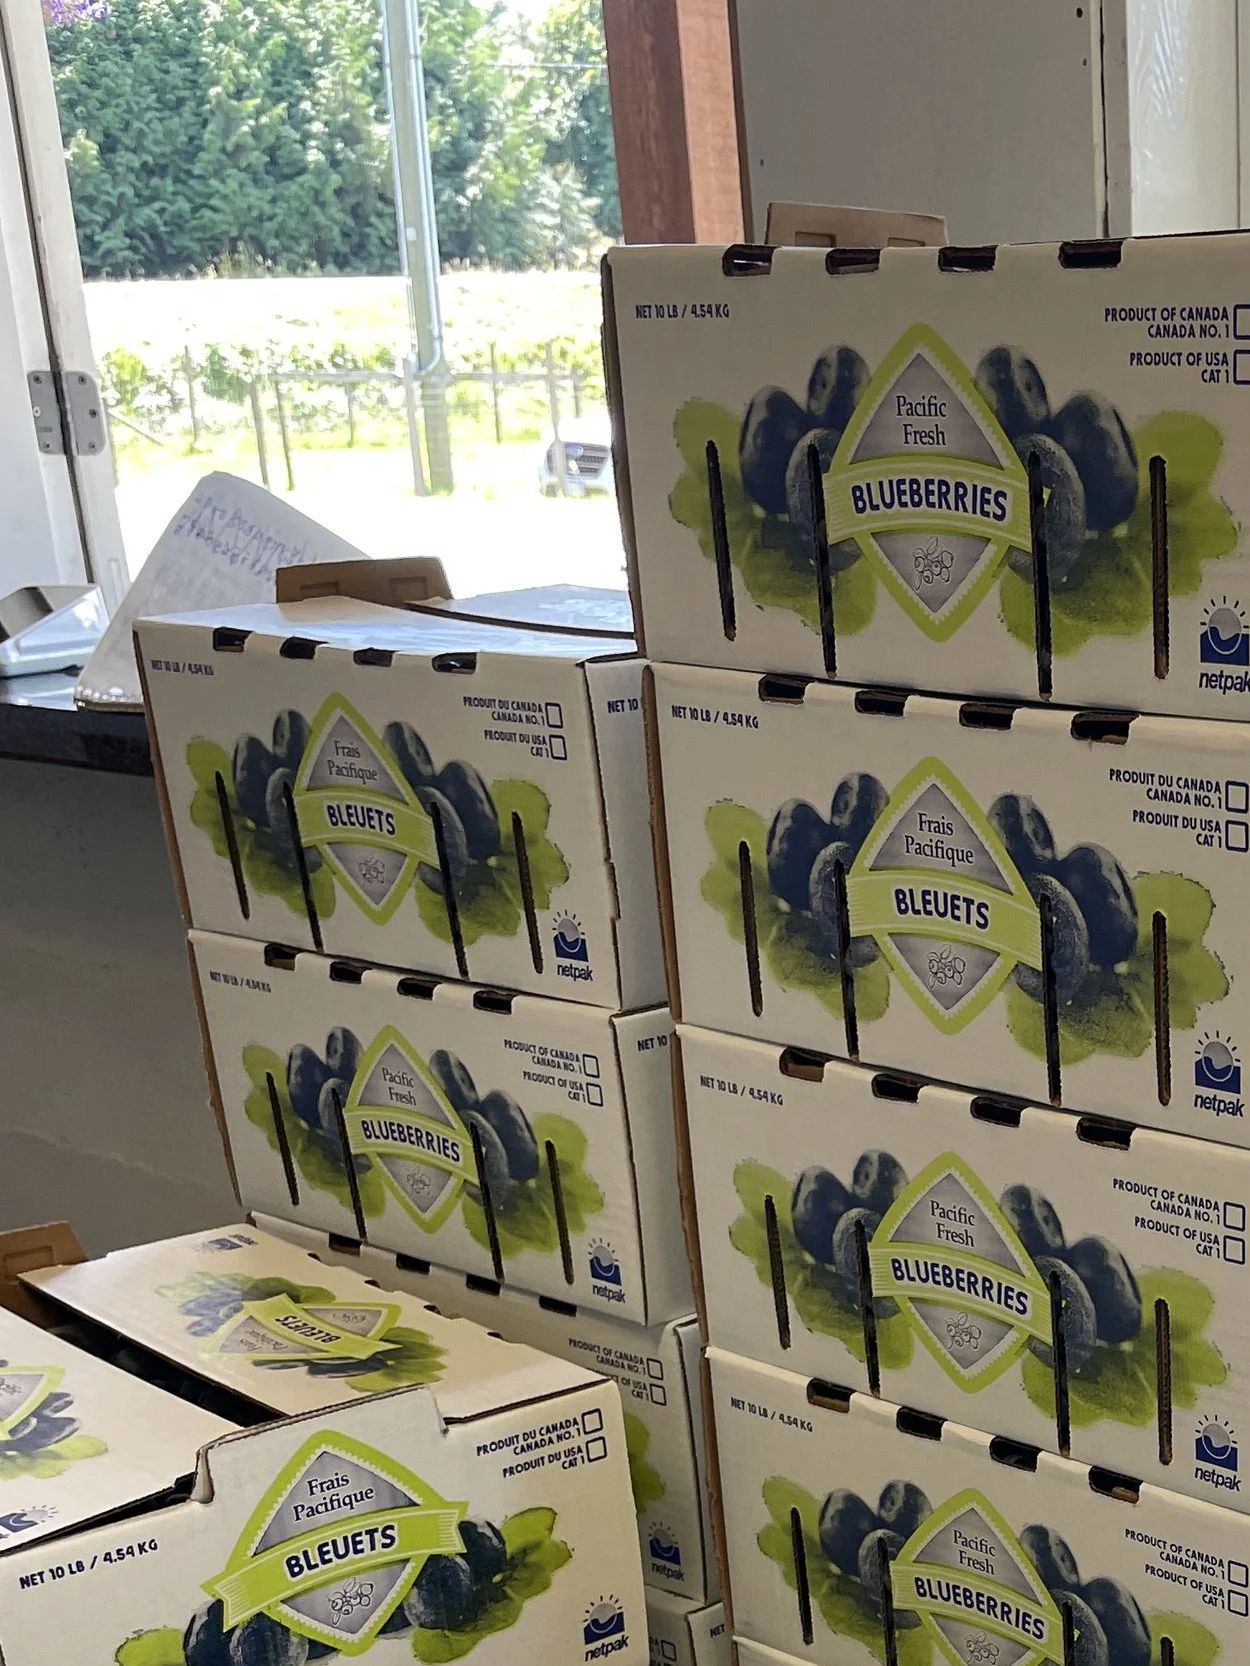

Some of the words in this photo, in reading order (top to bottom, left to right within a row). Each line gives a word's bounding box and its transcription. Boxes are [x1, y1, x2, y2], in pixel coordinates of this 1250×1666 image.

[636, 305, 652, 318] NET
[655, 304, 664, 318] 10
[667, 304, 678, 318] LB
[691, 304, 713, 318] 4.54
[715, 304, 729, 318] KG
[1105, 308, 1156, 322] PRODUCT
[1161, 307, 1176, 321] OF
[1180, 307, 1229, 321] CANADA
[1148, 324, 1195, 338] CANADA
[1200, 324, 1221, 338] NO.
[1130, 352, 1182, 366] PRODUCT
[1186, 352, 1202, 366] OF
[1206, 352, 1229, 366] USA
[1201, 369, 1221, 383] CAT
[896, 395, 946, 417] Pacific
[903, 424, 946, 445] Fresh
[852, 482, 1007, 521] BLUEBERRIES
[608, 700, 625, 713] NET
[628, 698, 638, 711] 10
[327, 804, 395, 835] BLEUETS
[918, 813, 953, 835] Frais
[905, 835, 973, 867] Pacifique
[895, 889, 988, 929] BLEUETS
[557, 963, 593, 981] netpak
[382, 1067, 414, 1088] Pacific
[388, 1087, 416, 1106] Fresh
[1194, 1094, 1245, 1117] netpak
[361, 1120, 460, 1162] BLUEBERRIES
[930, 1200, 974, 1226] Pacific
[936, 1222, 974, 1247] Fresh
[593, 1285, 625, 1303] netpak
[891, 1258, 1027, 1315] BLUEBERRIES
[477, 1435, 519, 1456] PRODUIT
[523, 1430, 536, 1442] DU
[539, 1417, 579, 1436] CANADA
[514, 1436, 554, 1455] CANADA
[556, 1431, 574, 1442] NO.
[503, 1456, 545, 1478] PRODUIT
[548, 1451, 561, 1463] DU
[564, 1445, 584, 1463] USA
[562, 1457, 577, 1469] CAT
[307, 1473, 349, 1500] Frais
[1195, 1467, 1241, 1491] netpak
[293, 1488, 374, 1525] Pacifique
[286, 1522, 400, 1580] BLEUETS
[954, 1530, 995, 1556] Pacific
[19, 1571, 44, 1589] NET
[49, 1567, 65, 1580] 10
[68, 1561, 85, 1574] LB
[103, 1546, 135, 1563] 4.54
[138, 1539, 157, 1555] KG
[959, 1550, 994, 1575] Fresh
[915, 1577, 1044, 1643] BLUEBERRIES
[585, 1635, 629, 1661] netpak
